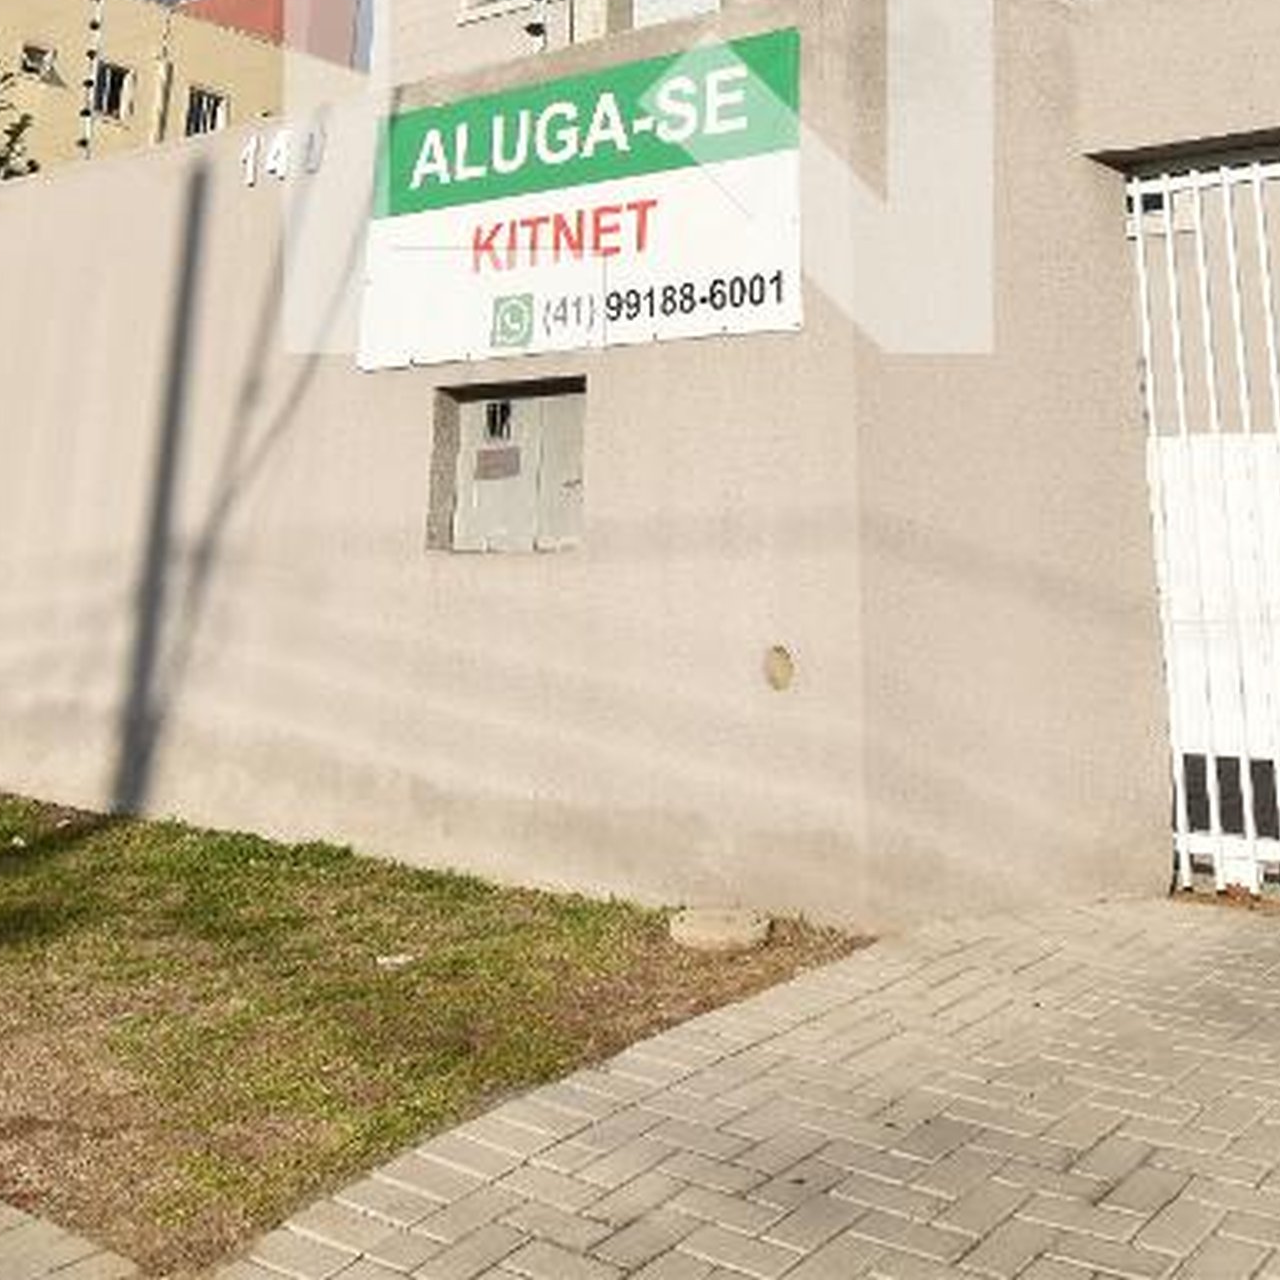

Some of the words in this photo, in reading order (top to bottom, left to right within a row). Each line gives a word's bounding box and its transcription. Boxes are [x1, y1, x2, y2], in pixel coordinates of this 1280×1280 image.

[408, 67, 749, 190] ALUGA-SE
[471, 199, 659, 274] KITNET
[541, 292, 597, 338] (41)
[604, 269, 785, 322] 99188-6001
